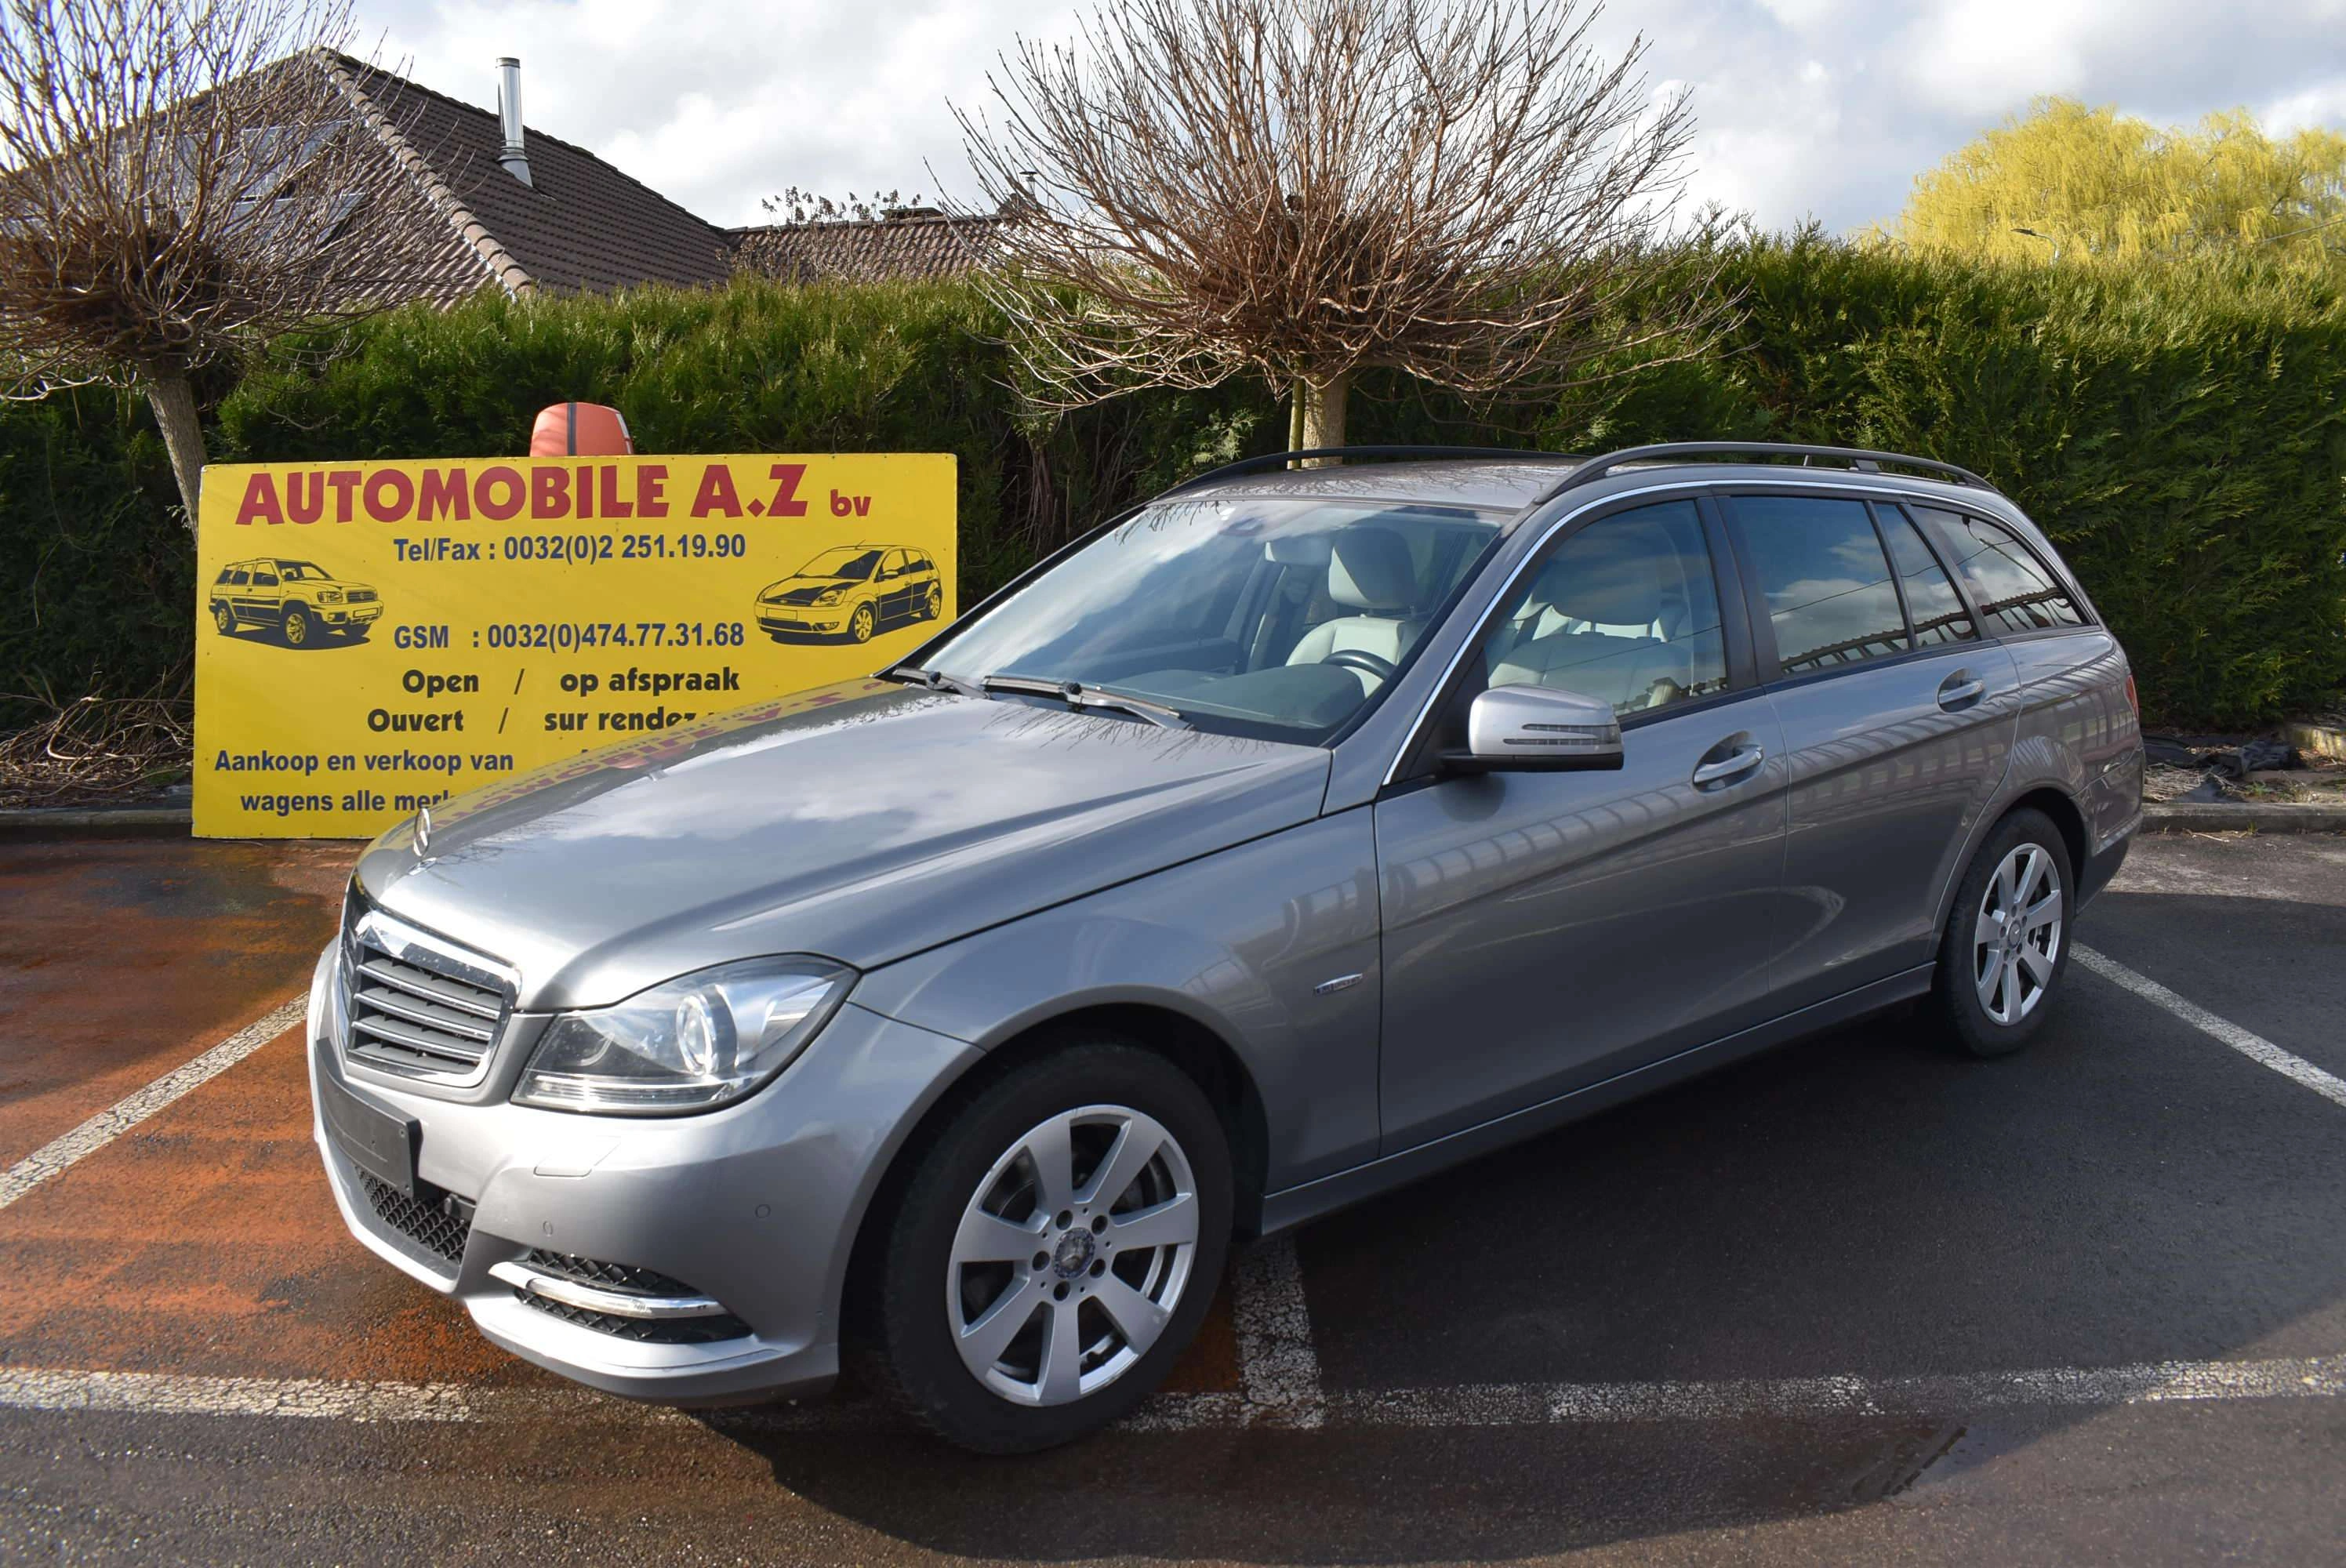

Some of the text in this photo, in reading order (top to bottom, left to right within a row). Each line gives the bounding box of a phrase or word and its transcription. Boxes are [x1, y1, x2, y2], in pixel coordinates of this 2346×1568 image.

[235, 464, 871, 524] AUTOMOBILE A.Z bv
[394, 537, 480, 561] Tel/Fax
[504, 535, 613, 564] 0032(0)2
[622, 534, 746, 557] 251.19.90
[394, 626, 448, 648] GSM
[488, 622, 744, 654] 0032(0)474.77.31.68
[403, 670, 478, 698] Open
[560, 674, 599, 697] op
[609, 666, 740, 696] afspraak
[368, 709, 463, 731] Ouvert
[545, 712, 588, 731] sur
[215, 750, 514, 776] Aankoop en verkoop van
[241, 795, 333, 817] wagens
[342, 790, 385, 811] alle
